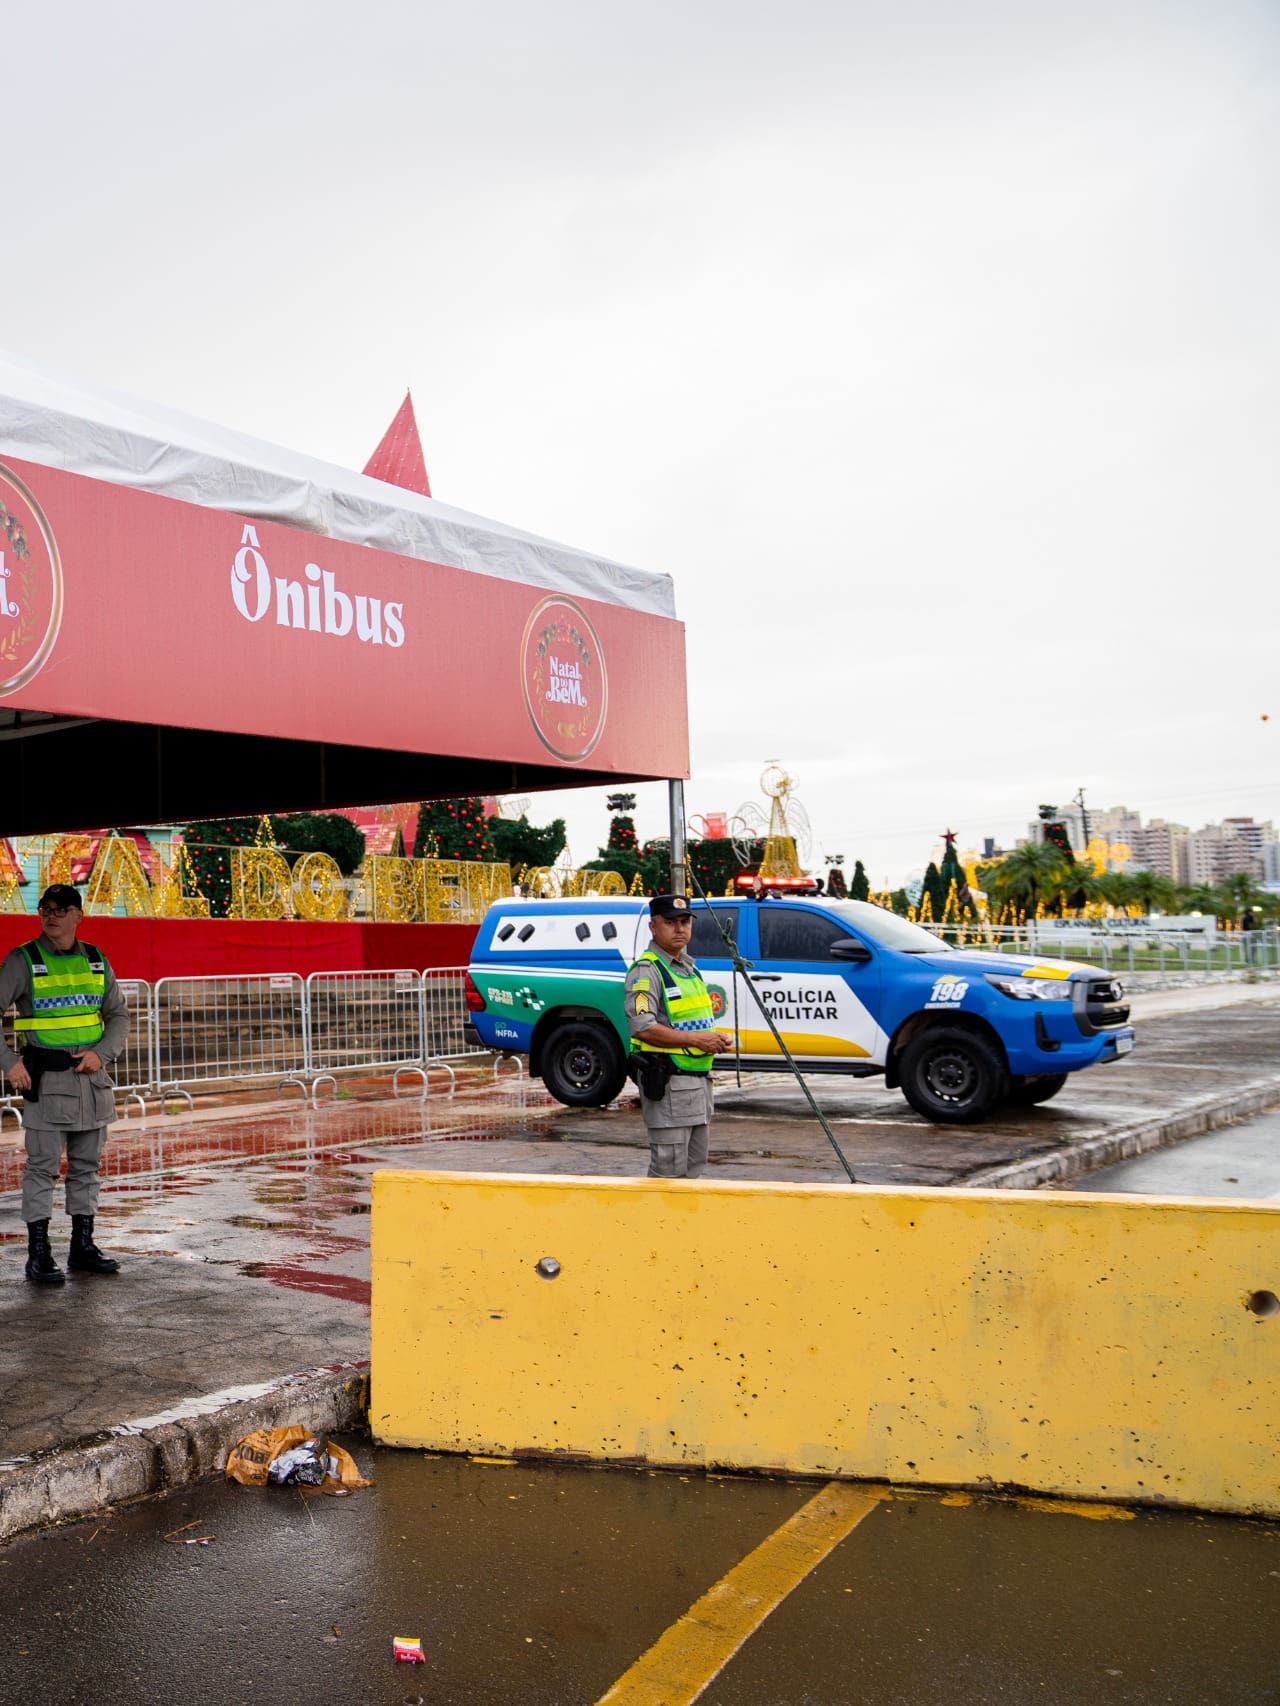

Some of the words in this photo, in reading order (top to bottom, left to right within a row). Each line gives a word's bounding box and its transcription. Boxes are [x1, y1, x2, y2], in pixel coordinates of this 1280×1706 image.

[230, 524, 405, 648] Ônibus
[549, 656, 582, 680] Natal
[373, 854, 513, 924] BEM
[762, 987, 837, 1003] POLÍCIA
[930, 982, 969, 1001] 198
[764, 1007, 839, 1020] MILITAR
